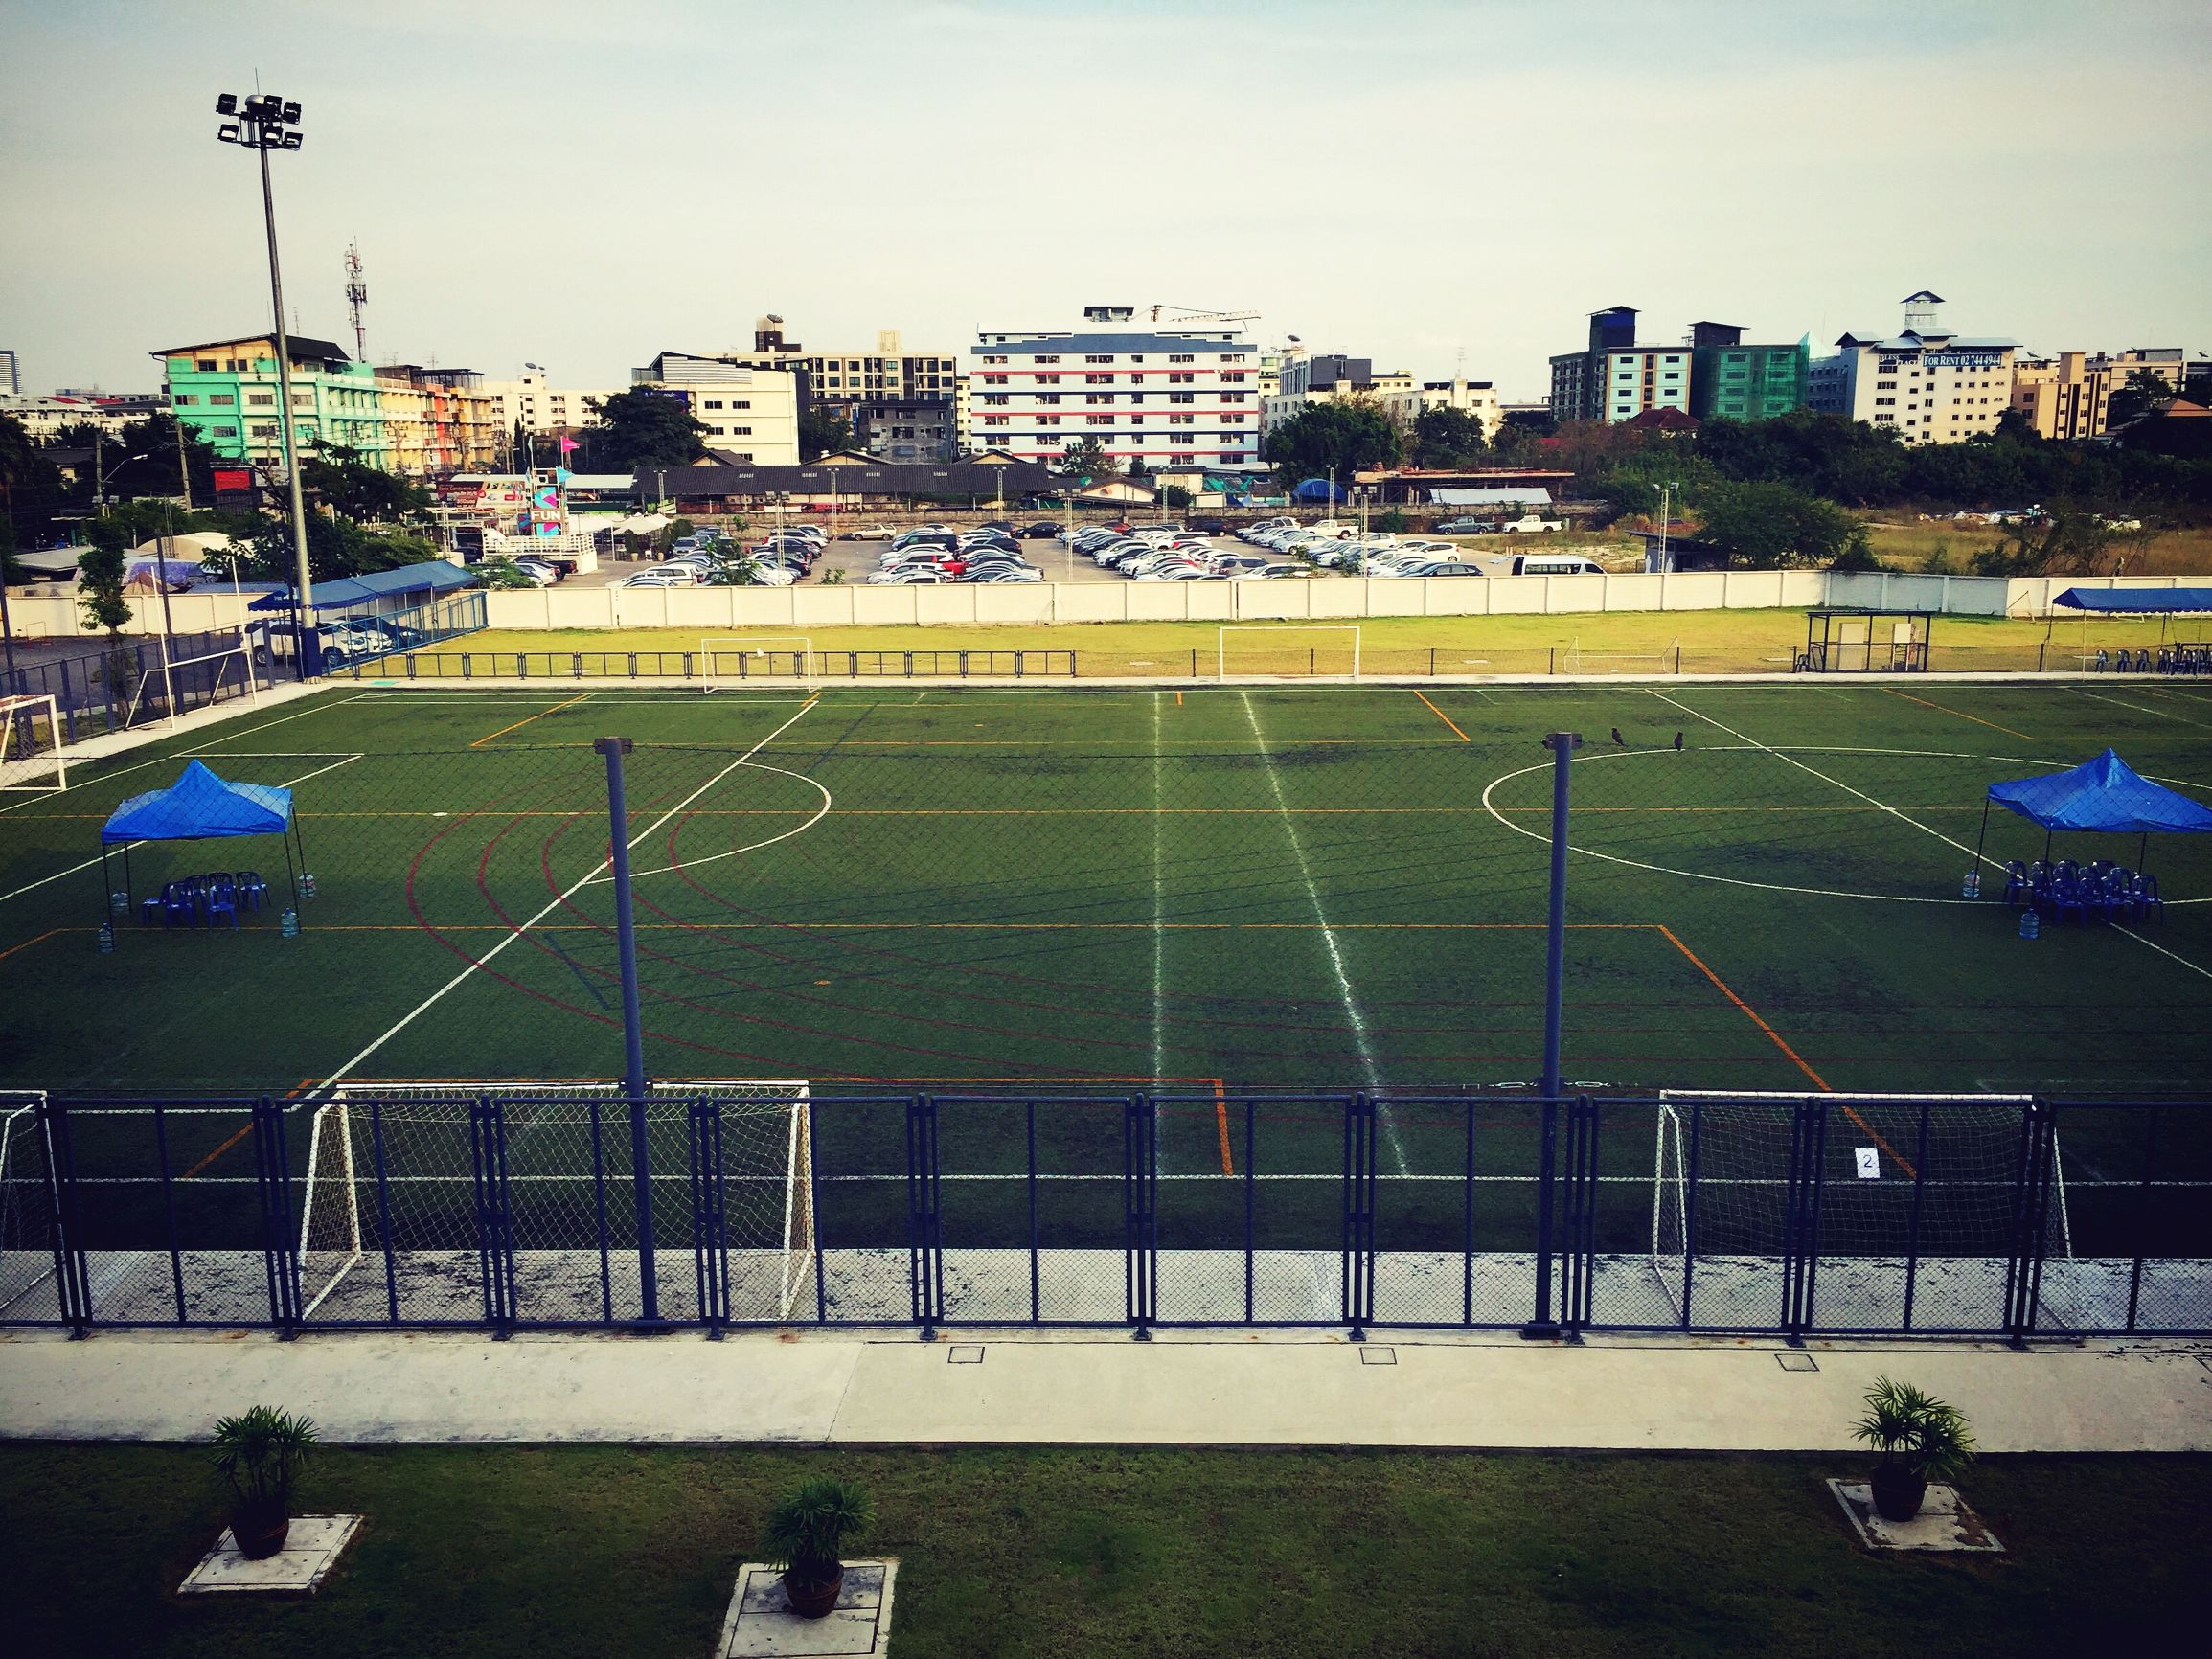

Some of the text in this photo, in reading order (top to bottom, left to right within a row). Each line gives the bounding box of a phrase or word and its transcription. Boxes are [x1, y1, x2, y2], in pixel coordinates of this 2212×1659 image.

[1924, 354, 2001, 366] FOR RENT 02 744 4944
[531, 510, 561, 521] FUN
[1863, 1154, 1873, 1168] 2
